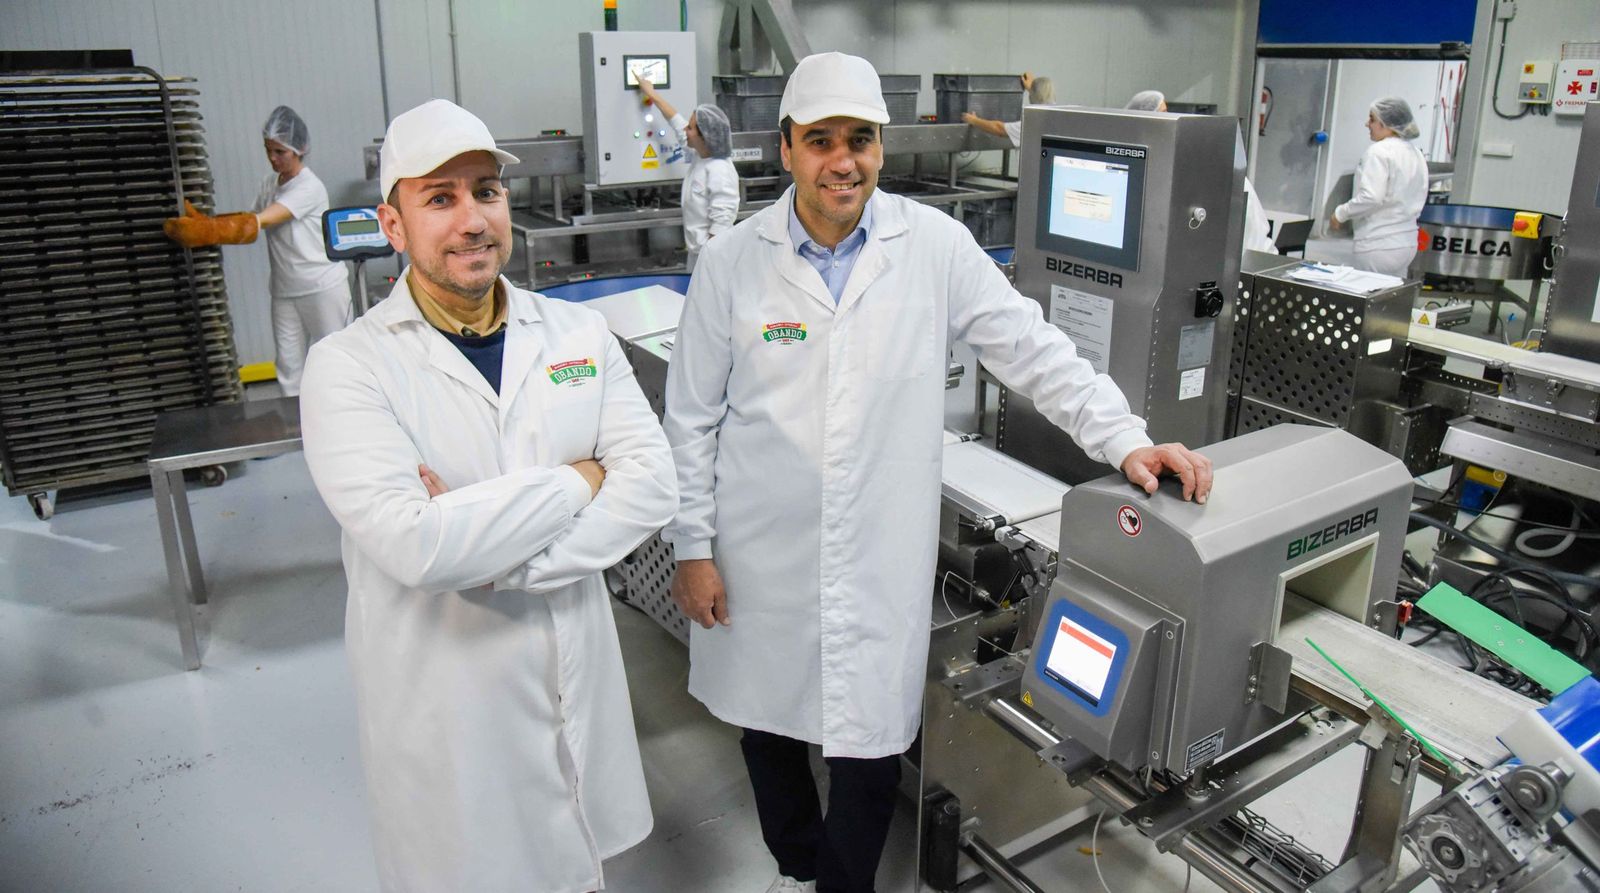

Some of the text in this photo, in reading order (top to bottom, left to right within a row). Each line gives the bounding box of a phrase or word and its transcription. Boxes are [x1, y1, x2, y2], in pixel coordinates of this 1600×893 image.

[1105, 146, 1145, 158] BIZERBA
[1431, 235, 1512, 257] BELCA
[1046, 257, 1123, 289] BIZERBA
[767, 329, 802, 340] OBANDO
[554, 366, 592, 382] OBANDO
[1286, 507, 1379, 561] BIZERBA
